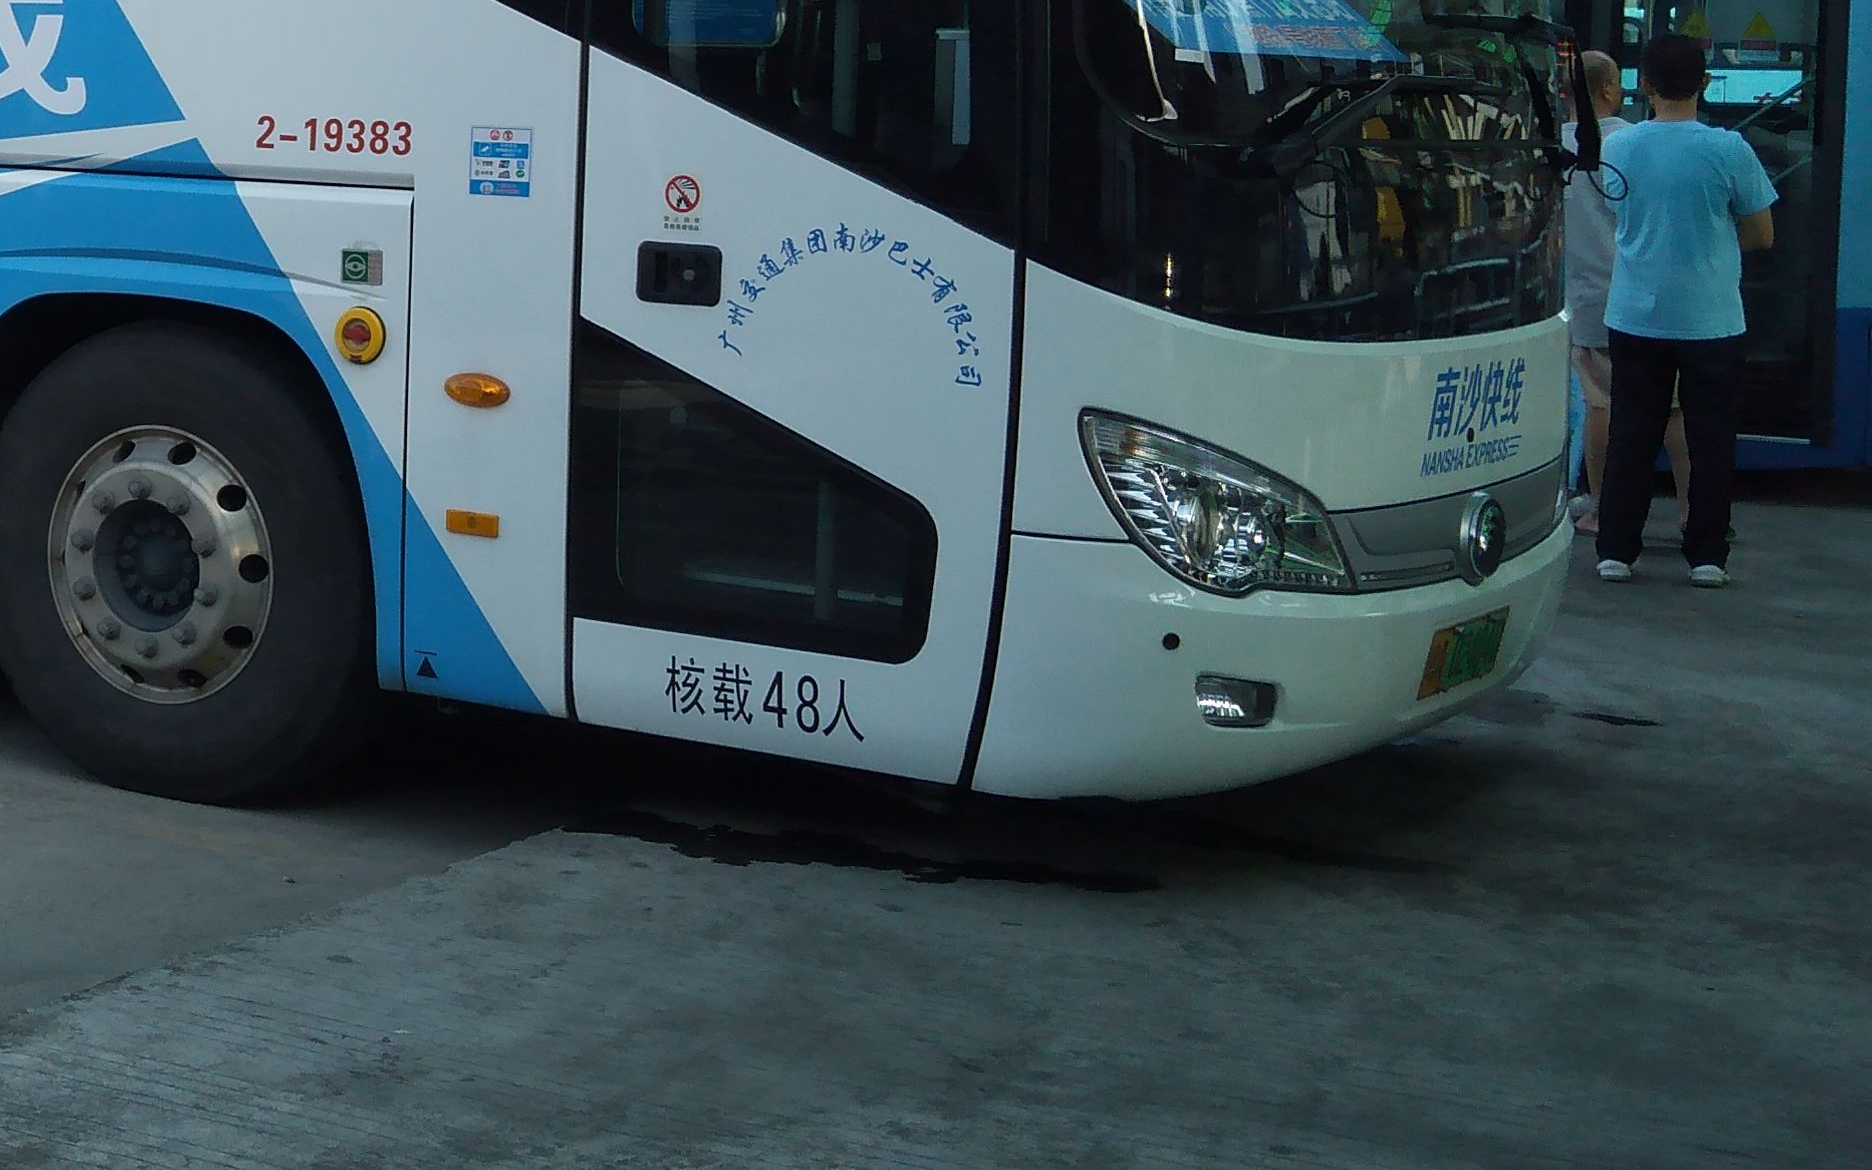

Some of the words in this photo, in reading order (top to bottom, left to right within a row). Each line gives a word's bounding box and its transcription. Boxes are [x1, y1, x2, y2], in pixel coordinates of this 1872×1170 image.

[255, 115, 413, 157] 2-19383
[717, 222, 982, 388] 广州交通集团南沙巴士有限公司
[1428, 357, 1526, 441] 南沙快线
[1420, 447, 1464, 477] NANSHA
[1466, 438, 1510, 469] EXPRESS
[666, 654, 867, 743] 核载48人
